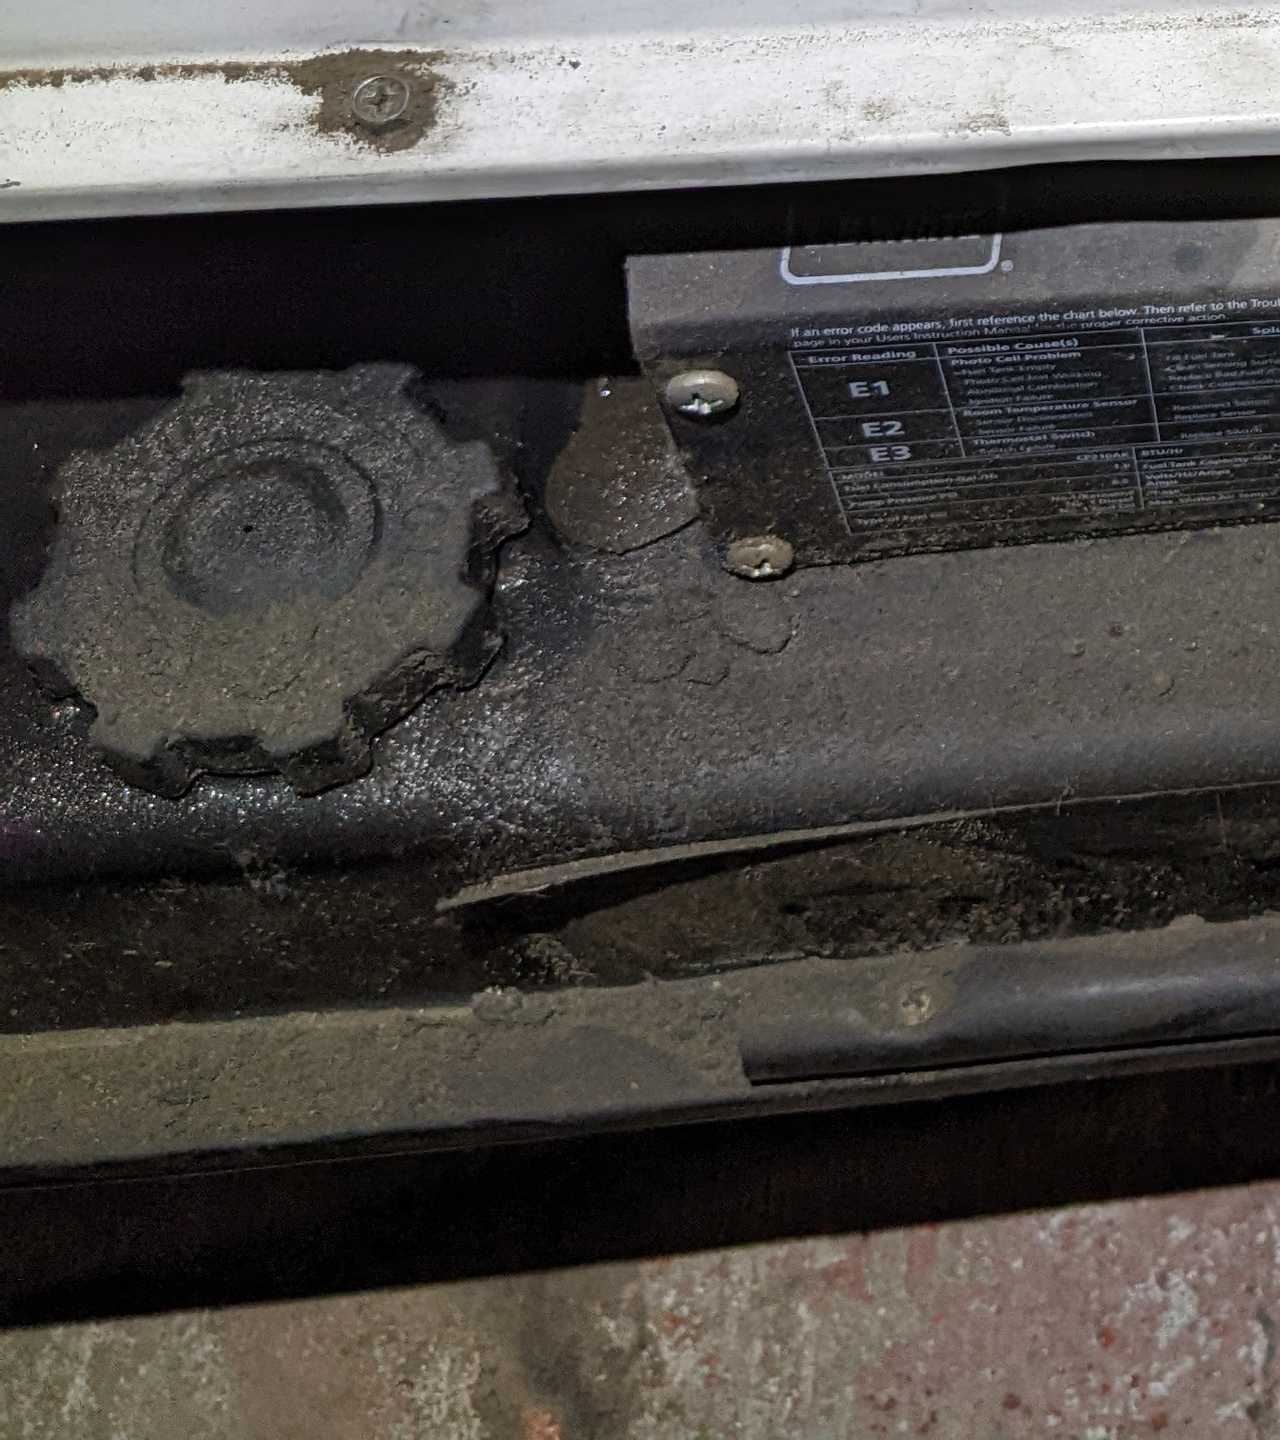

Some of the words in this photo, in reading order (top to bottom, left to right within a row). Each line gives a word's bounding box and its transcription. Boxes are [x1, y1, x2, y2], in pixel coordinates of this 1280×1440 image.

[803, 328, 820, 337] an
[823, 327, 854, 336] error
[857, 322, 889, 335] code
[892, 319, 946, 332] appears,
[949, 317, 974, 328] first
[976, 313, 1036, 327] reference
[1038, 311, 1060, 322] the
[1063, 309, 1096, 321] chart
[1143, 304, 1175, 316] Then
[1177, 302, 1208, 313] refer
[1210, 301, 1225, 311] to
[1226, 299, 1248, 310] the
[1125, 315, 1185, 326] corrective
[793, 339, 825, 350] page
[844, 336, 873, 347] your
[946, 343, 1011, 355] Possible
[1013, 337, 1080, 351] Cause(s)
[807, 355, 848, 365] Error
[851, 350, 917, 363] Reading
[950, 356, 993, 366] Photo
[1024, 350, 1082, 362] Problem
[848, 379, 891, 399] E1
[962, 408, 1003, 417] Room
[1006, 401, 1090, 414] Temperature
[1092, 398, 1138, 409] Sensor
[861, 419, 906, 438] E2
[974, 433, 1048, 446] Thermostat
[1049, 429, 1096, 440] Switch
[869, 444, 913, 463] E3
